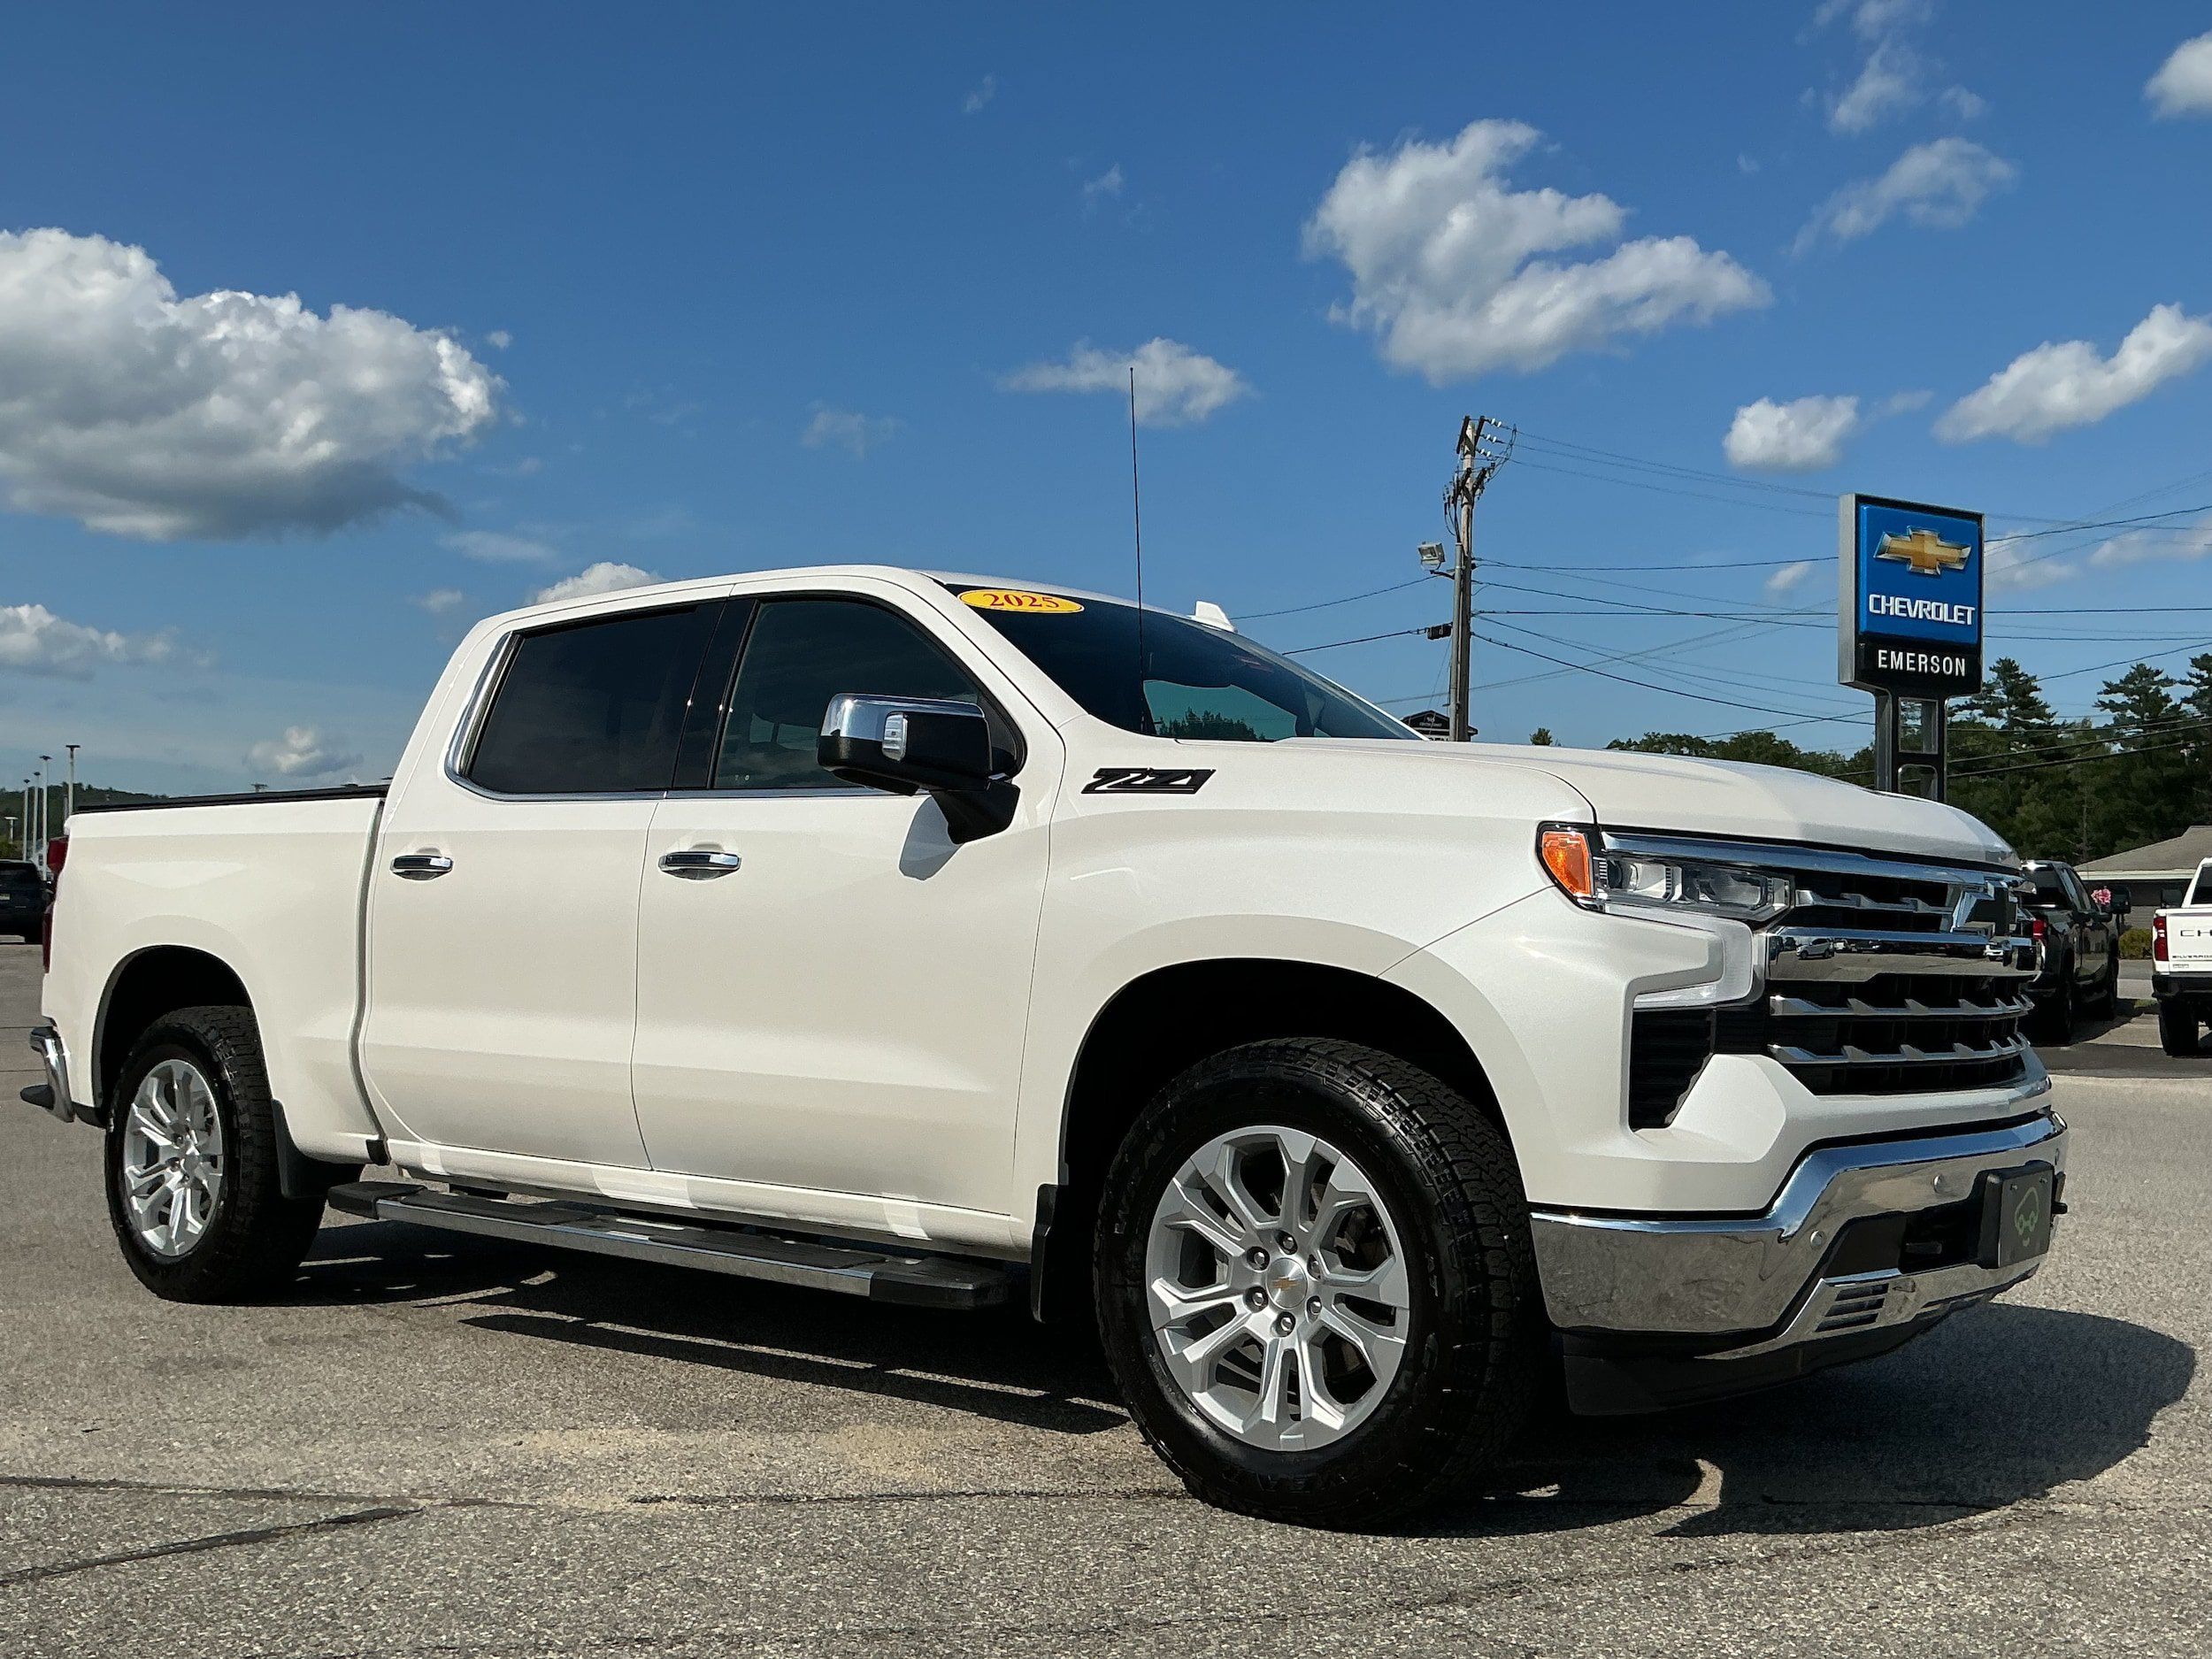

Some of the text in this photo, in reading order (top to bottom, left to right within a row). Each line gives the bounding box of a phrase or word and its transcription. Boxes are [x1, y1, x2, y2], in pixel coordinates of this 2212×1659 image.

[983, 593, 1059, 609] 2025
[1869, 594, 1976, 626] CHEVROLET
[1878, 649, 1965, 677] EMERSON
